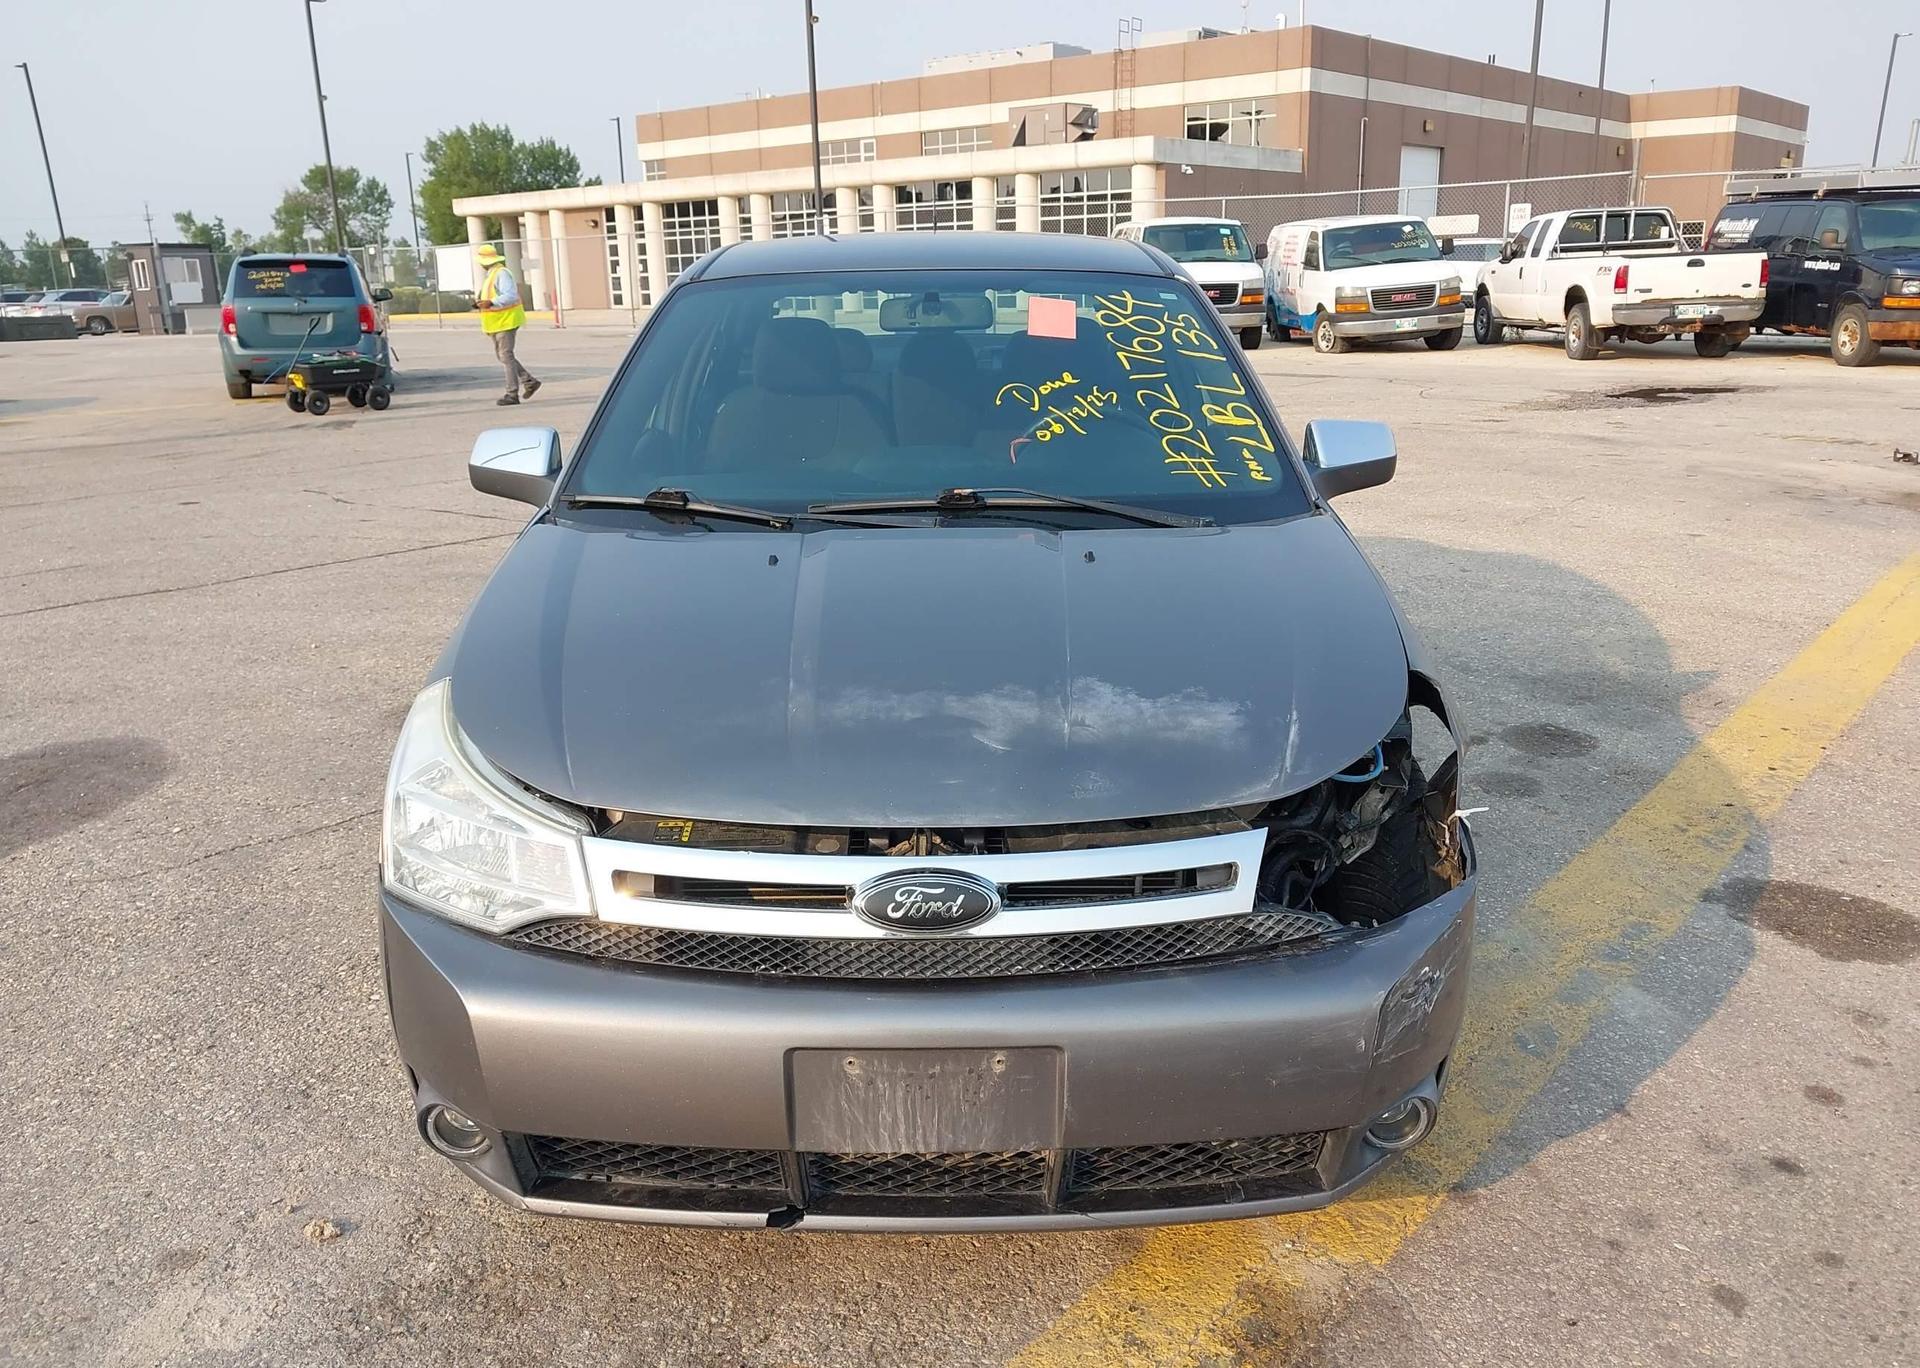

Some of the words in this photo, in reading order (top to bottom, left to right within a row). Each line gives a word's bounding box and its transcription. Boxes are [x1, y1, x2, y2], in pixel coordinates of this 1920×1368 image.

[995, 371, 1081, 412] Done
[1094, 289, 1238, 488] #20217684
[886, 886, 966, 919] Ford
